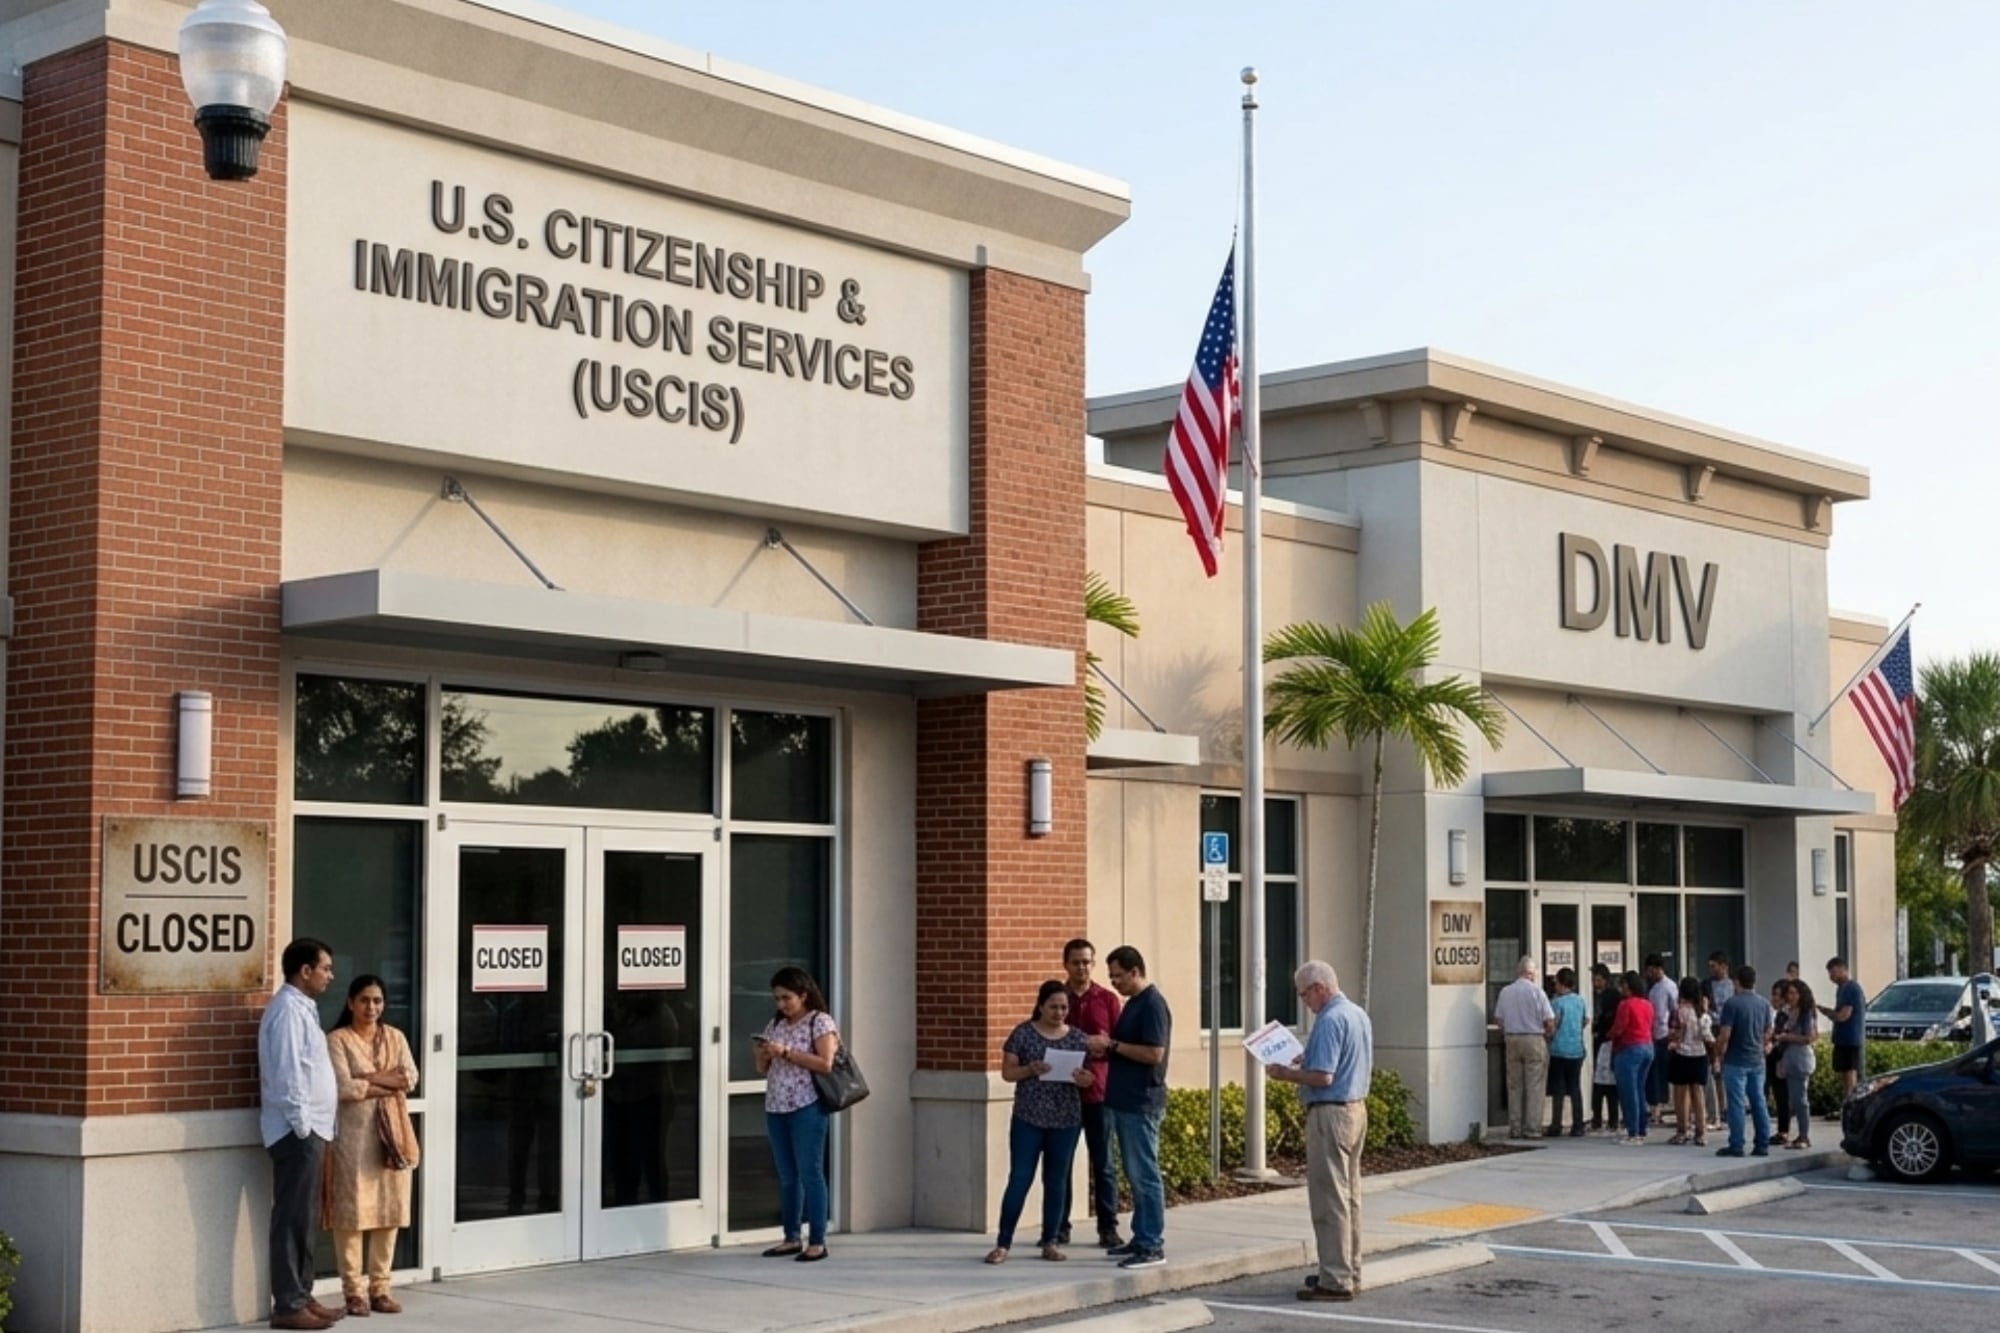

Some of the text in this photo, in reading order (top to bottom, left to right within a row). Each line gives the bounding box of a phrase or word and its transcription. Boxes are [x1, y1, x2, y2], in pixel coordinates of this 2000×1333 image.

[430, 179, 866, 325] U.S. CITIZENSHIP &
[354, 238, 915, 401] IMMIGRATION SERVICES
[572, 357, 745, 444] (USCIS)
[1558, 531, 1719, 651] DMV
[133, 843, 242, 885] USCIS
[116, 912, 255, 954] CLOSED
[1442, 912, 1472, 933] DMV
[476, 947, 543, 970] CLOSED
